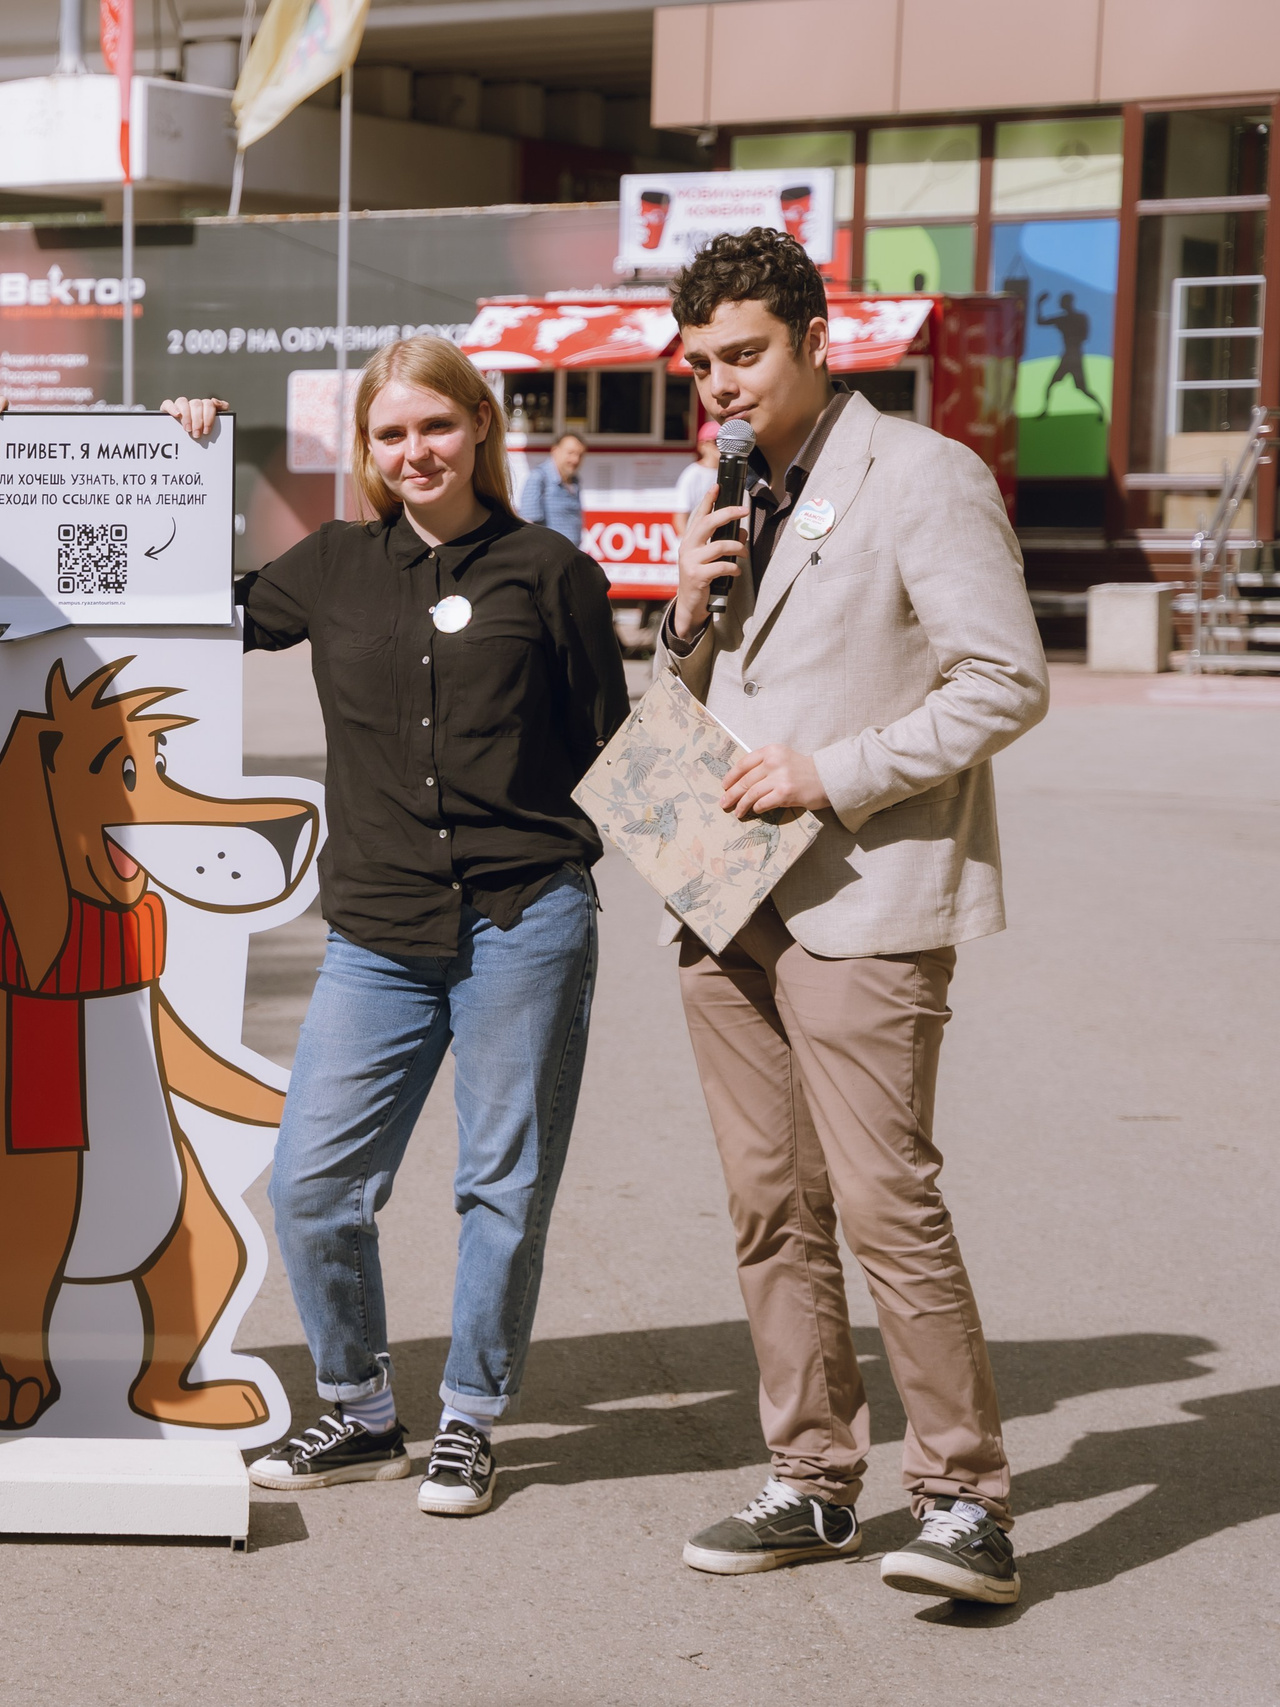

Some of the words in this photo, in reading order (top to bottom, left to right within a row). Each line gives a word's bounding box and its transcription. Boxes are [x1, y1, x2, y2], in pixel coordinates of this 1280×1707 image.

[167, 330, 183, 354] 2
[185, 330, 227, 354] 000
[247, 328, 280, 353] НА
[6, 443, 74, 460] ПРИВЕТ,
[81, 443, 90, 459] Я
[97, 443, 178, 459] МАМПУС!
[19, 474, 65, 485] ХОЧЕШЬ
[71, 474, 118, 486] УЗНАТЬ,
[123, 474, 146, 485] КТО
[151, 474, 158, 485] Я
[42, 494, 58, 505] ПО
[63, 494, 110, 505] ССЫЛКЕ
[116, 494, 132, 505] QR
[137, 494, 152, 505] НА
[156, 494, 208, 506] ЛЕНДИНГ
